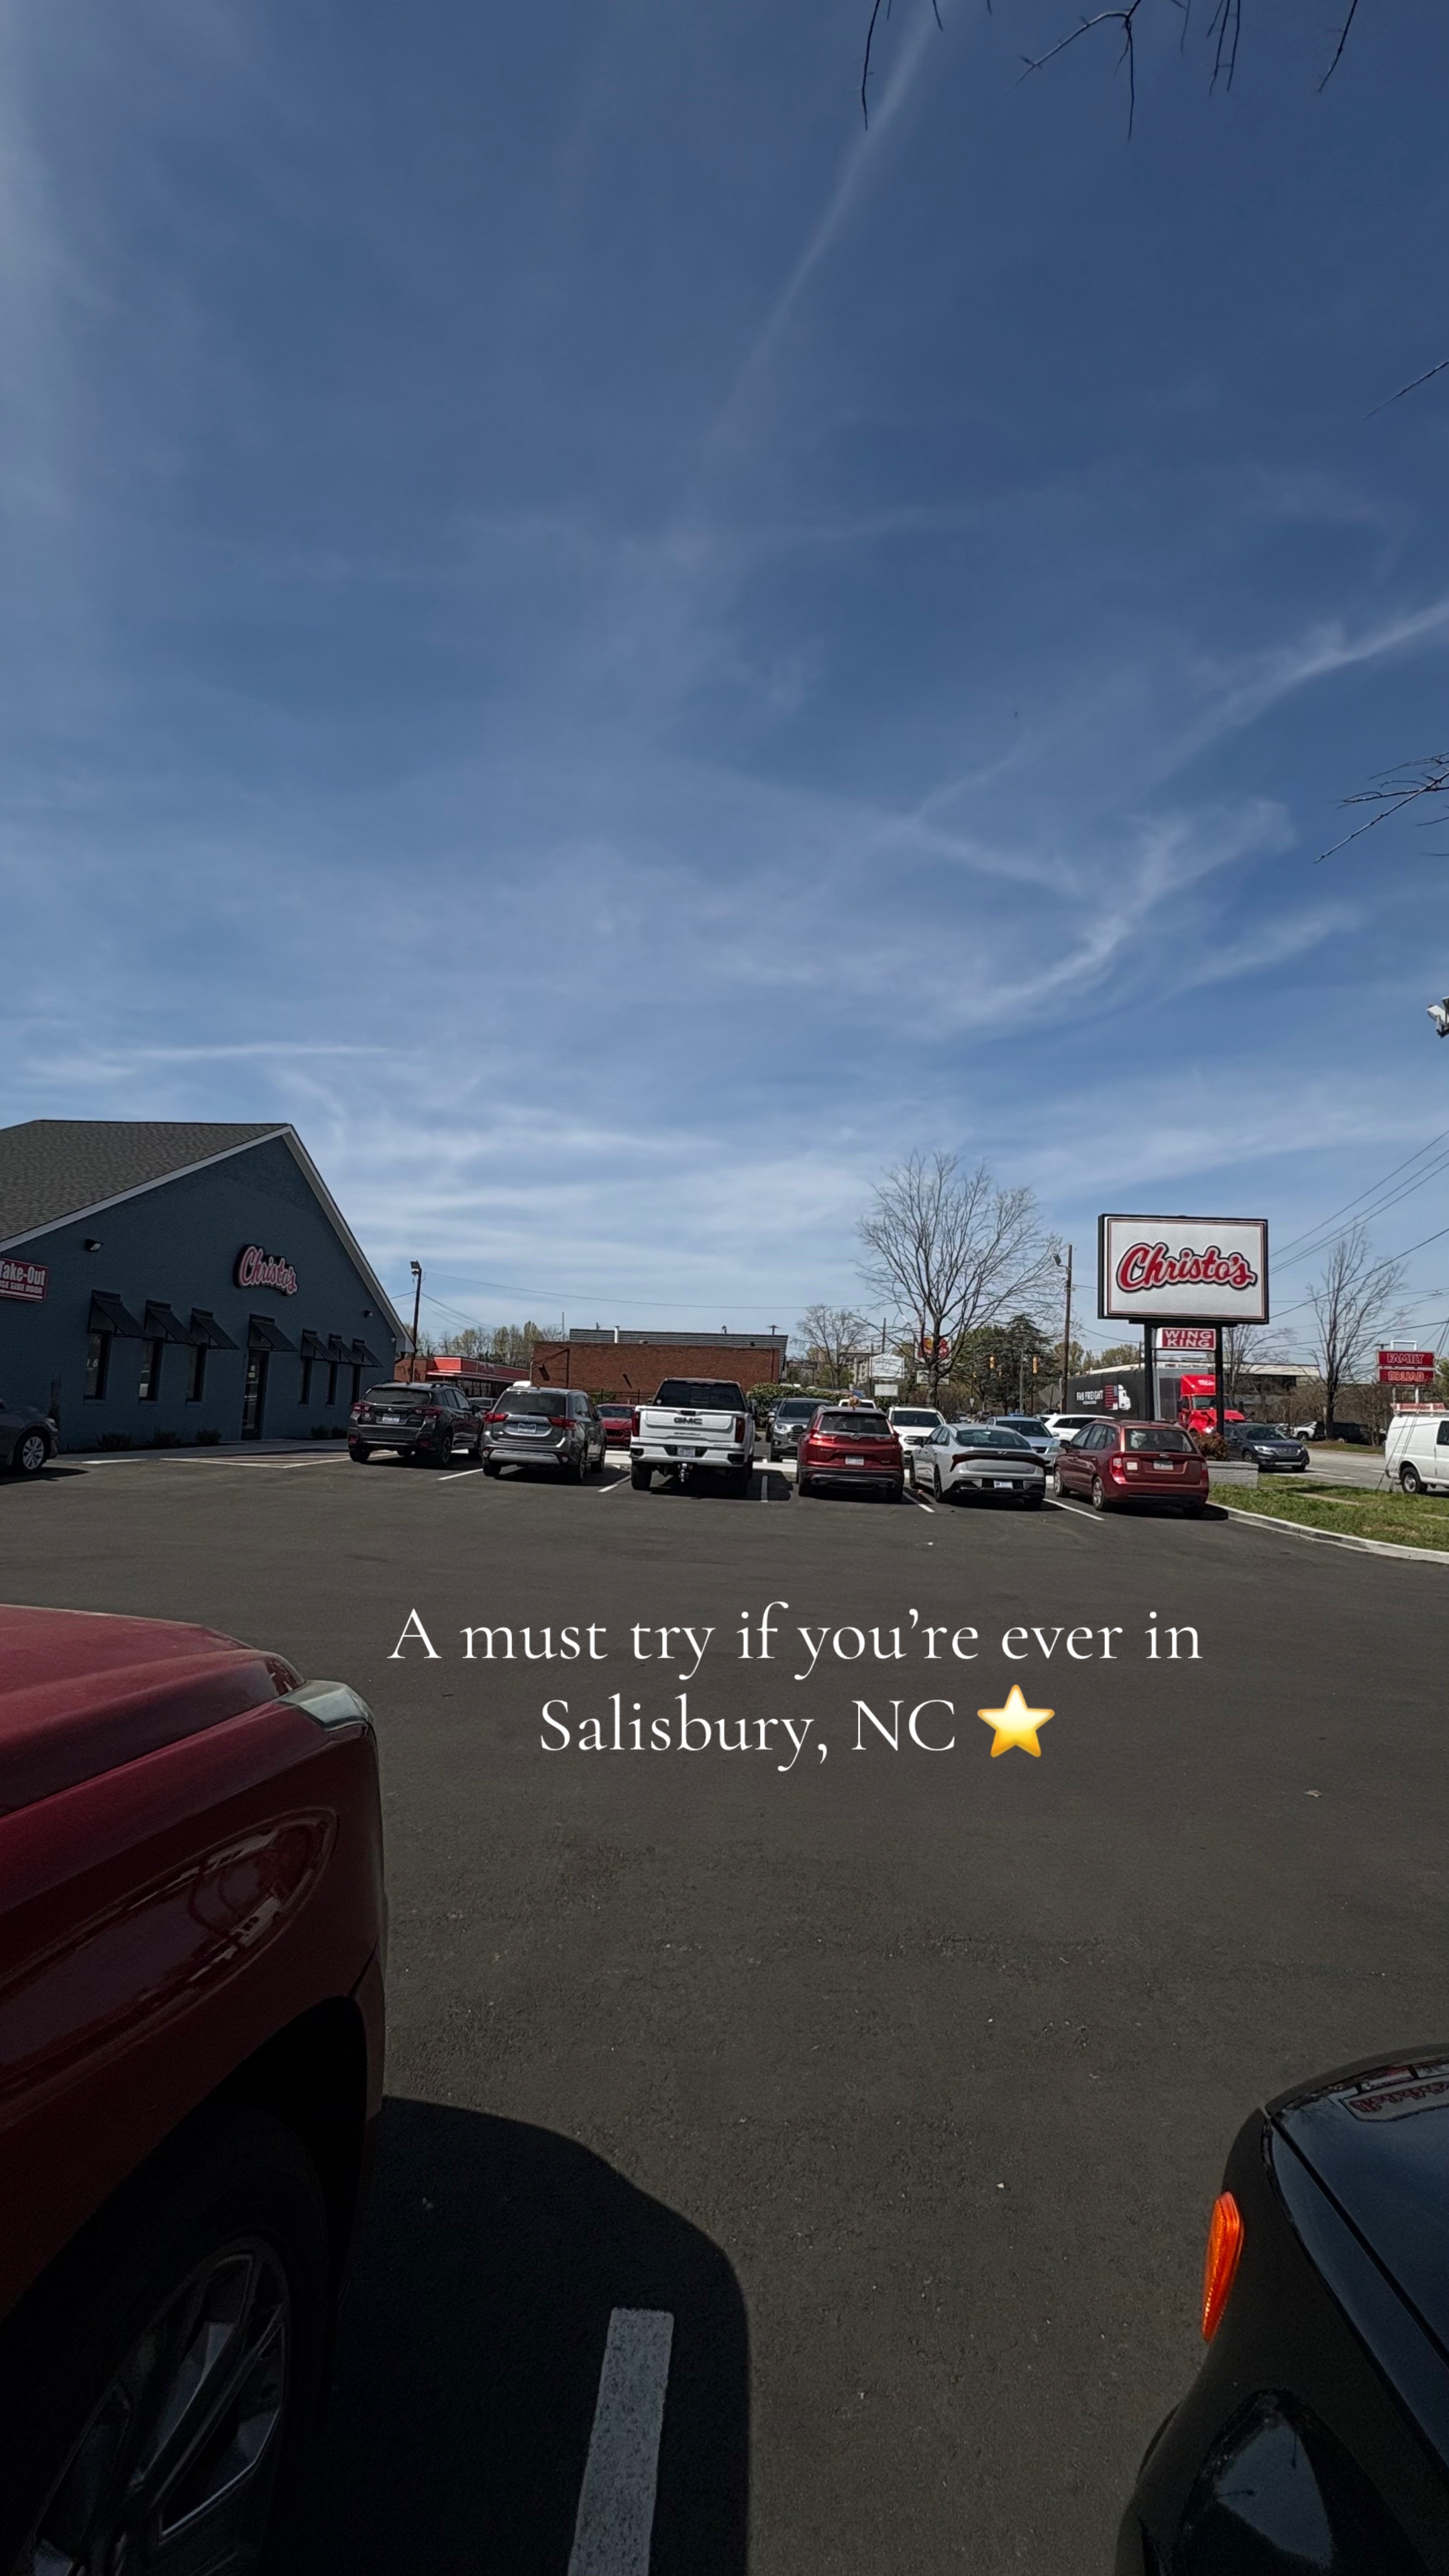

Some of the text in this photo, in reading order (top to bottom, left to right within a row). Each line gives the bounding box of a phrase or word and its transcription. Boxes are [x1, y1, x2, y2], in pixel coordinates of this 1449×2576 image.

[239, 1246, 297, 1295] Christo's
[1117, 1242, 1257, 1292] Christo's
[0, 1260, 46, 1287] Take-Out
[1165, 1330, 1212, 1340] WING
[1167, 1338, 1210, 1348] KING
[1387, 1353, 1424, 1364] FAMILY
[1387, 1371, 1425, 1382] DOLLAR
[674, 1417, 703, 1425] GMC
